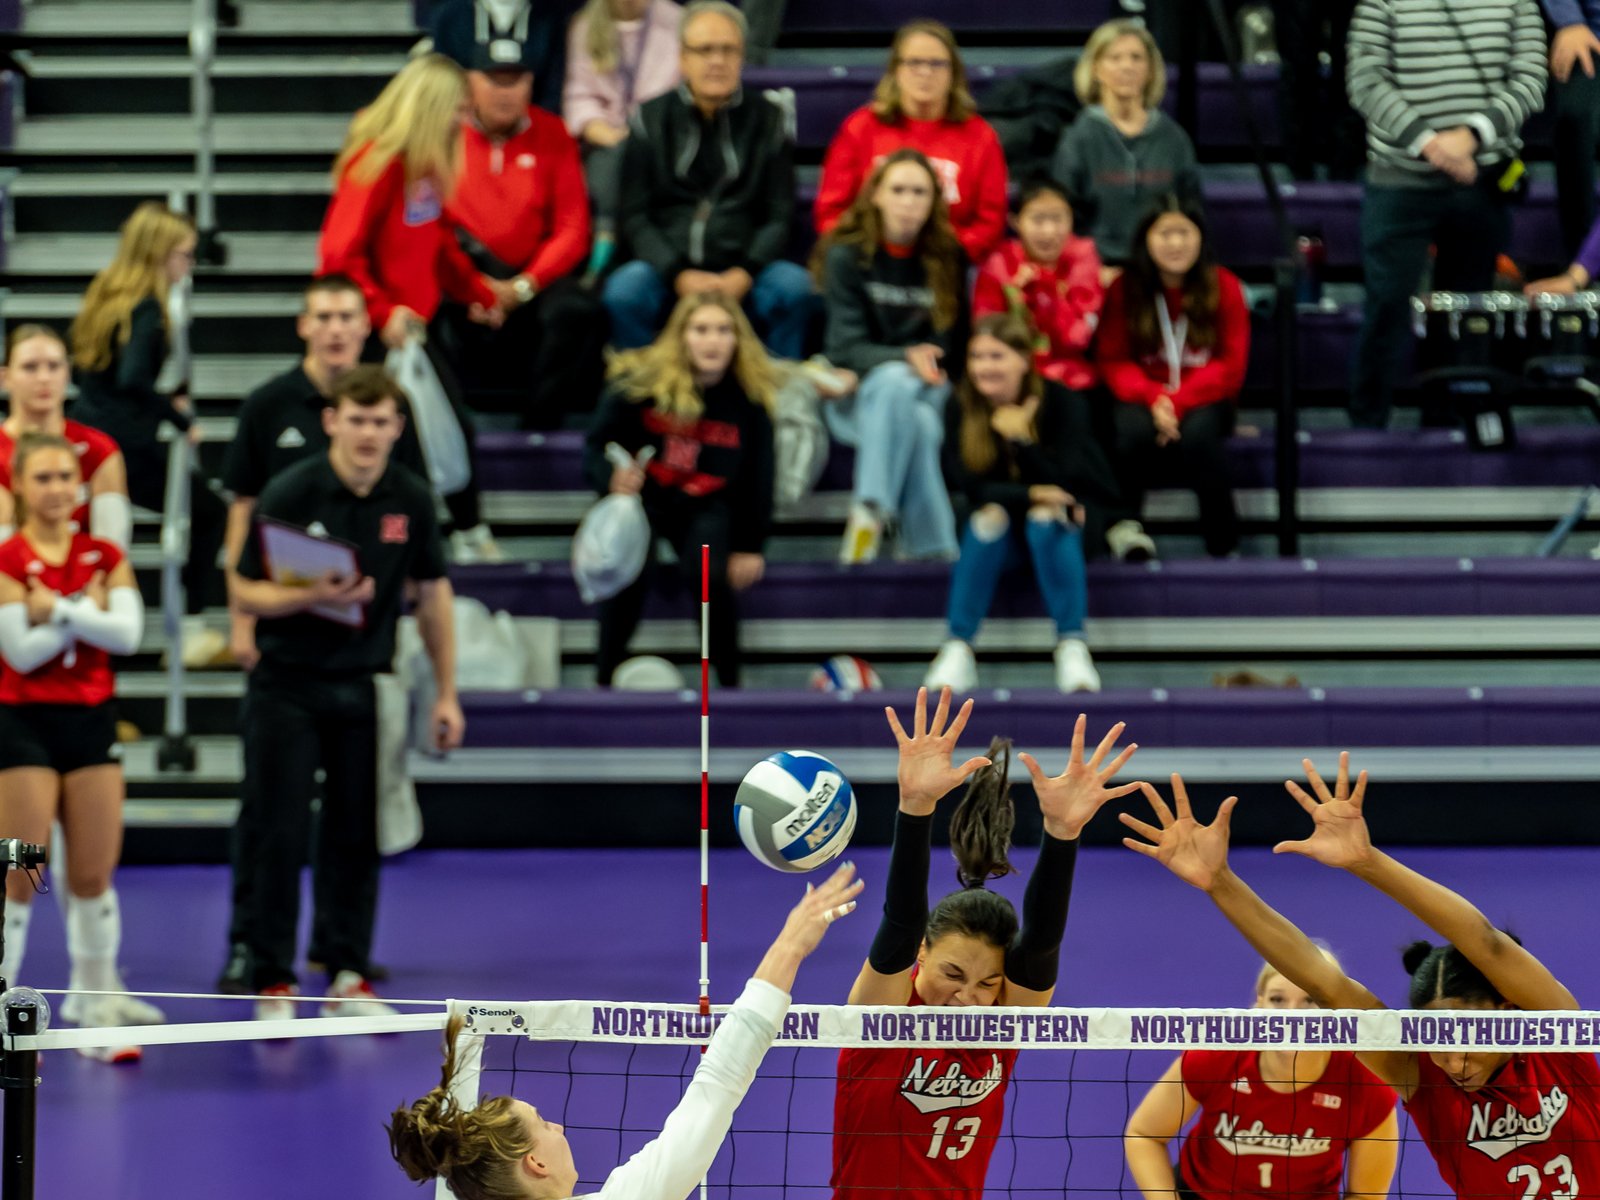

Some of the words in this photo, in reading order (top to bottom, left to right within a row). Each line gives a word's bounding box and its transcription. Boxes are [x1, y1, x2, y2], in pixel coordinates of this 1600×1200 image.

[479, 1008, 516, 1017] Senoh
[592, 1007, 820, 1040] NORTHWRN
[861, 1012, 1089, 1043] NORTHWESTERN
[1130, 1015, 1359, 1044] NORTHWESTERN
[926, 1116, 982, 1160] 13
[1214, 1112, 1331, 1152] Nebraska
[1258, 1162, 1273, 1188] 1
